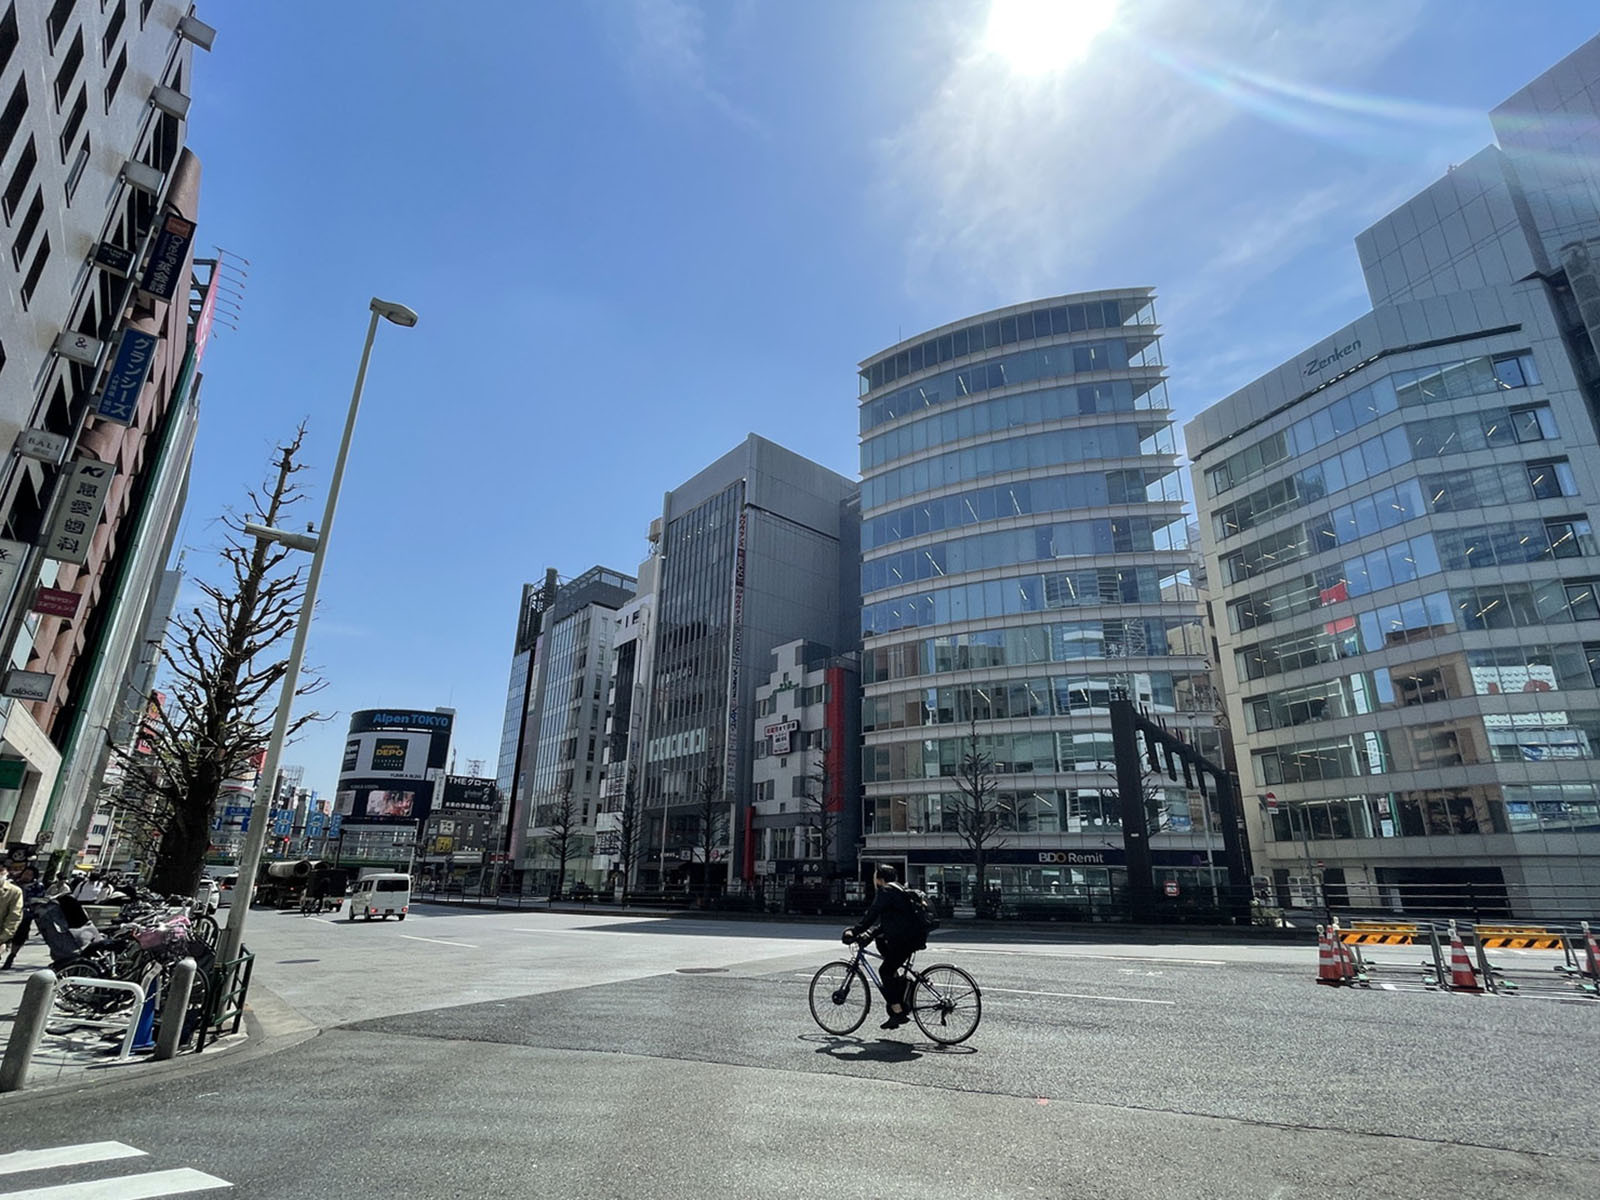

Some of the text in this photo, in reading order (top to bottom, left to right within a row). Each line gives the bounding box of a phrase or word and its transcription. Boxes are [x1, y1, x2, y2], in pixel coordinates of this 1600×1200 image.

[1304, 340, 1362, 376] Zenken
[110, 338, 153, 416] グランシーズ
[373, 713, 449, 726] Alpen TOKYO
[1038, 852, 1104, 863] BDO Remit
